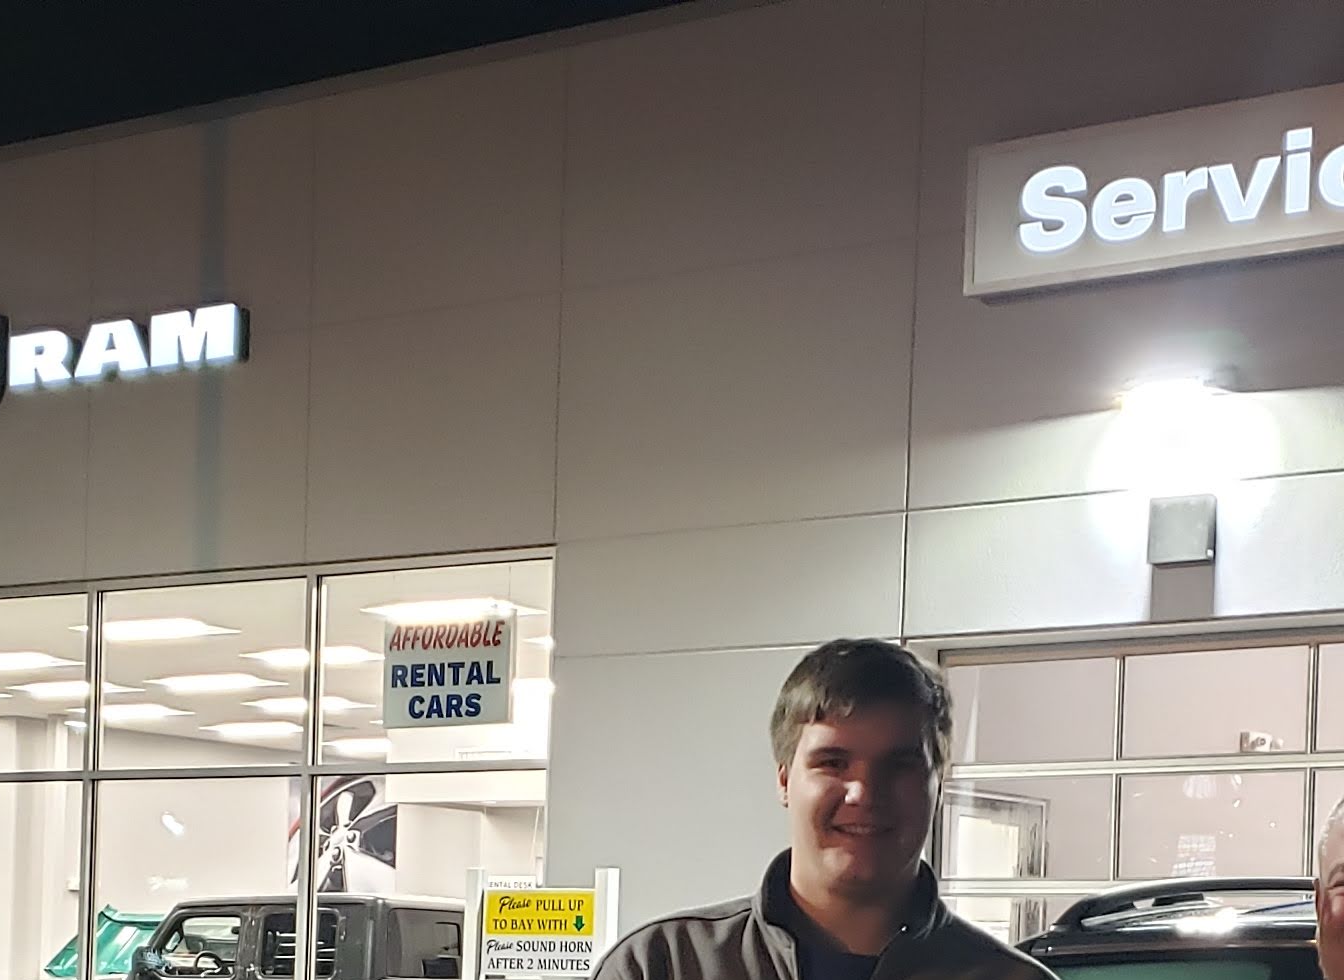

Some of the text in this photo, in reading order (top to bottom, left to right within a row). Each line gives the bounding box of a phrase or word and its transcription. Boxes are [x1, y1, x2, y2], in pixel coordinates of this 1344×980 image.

[8, 302, 244, 389] RAM
[389, 619, 506, 651] AFFORDABLE
[391, 660, 501, 688] RENTAL
[408, 692, 482, 719] CARS
[499, 896, 584, 914] Please PULL UP
[492, 918, 568, 931] TO BAY WITH
[486, 939, 593, 955] Please SOUND HORN
[487, 957, 591, 971] AFTER 2 MINUTES
